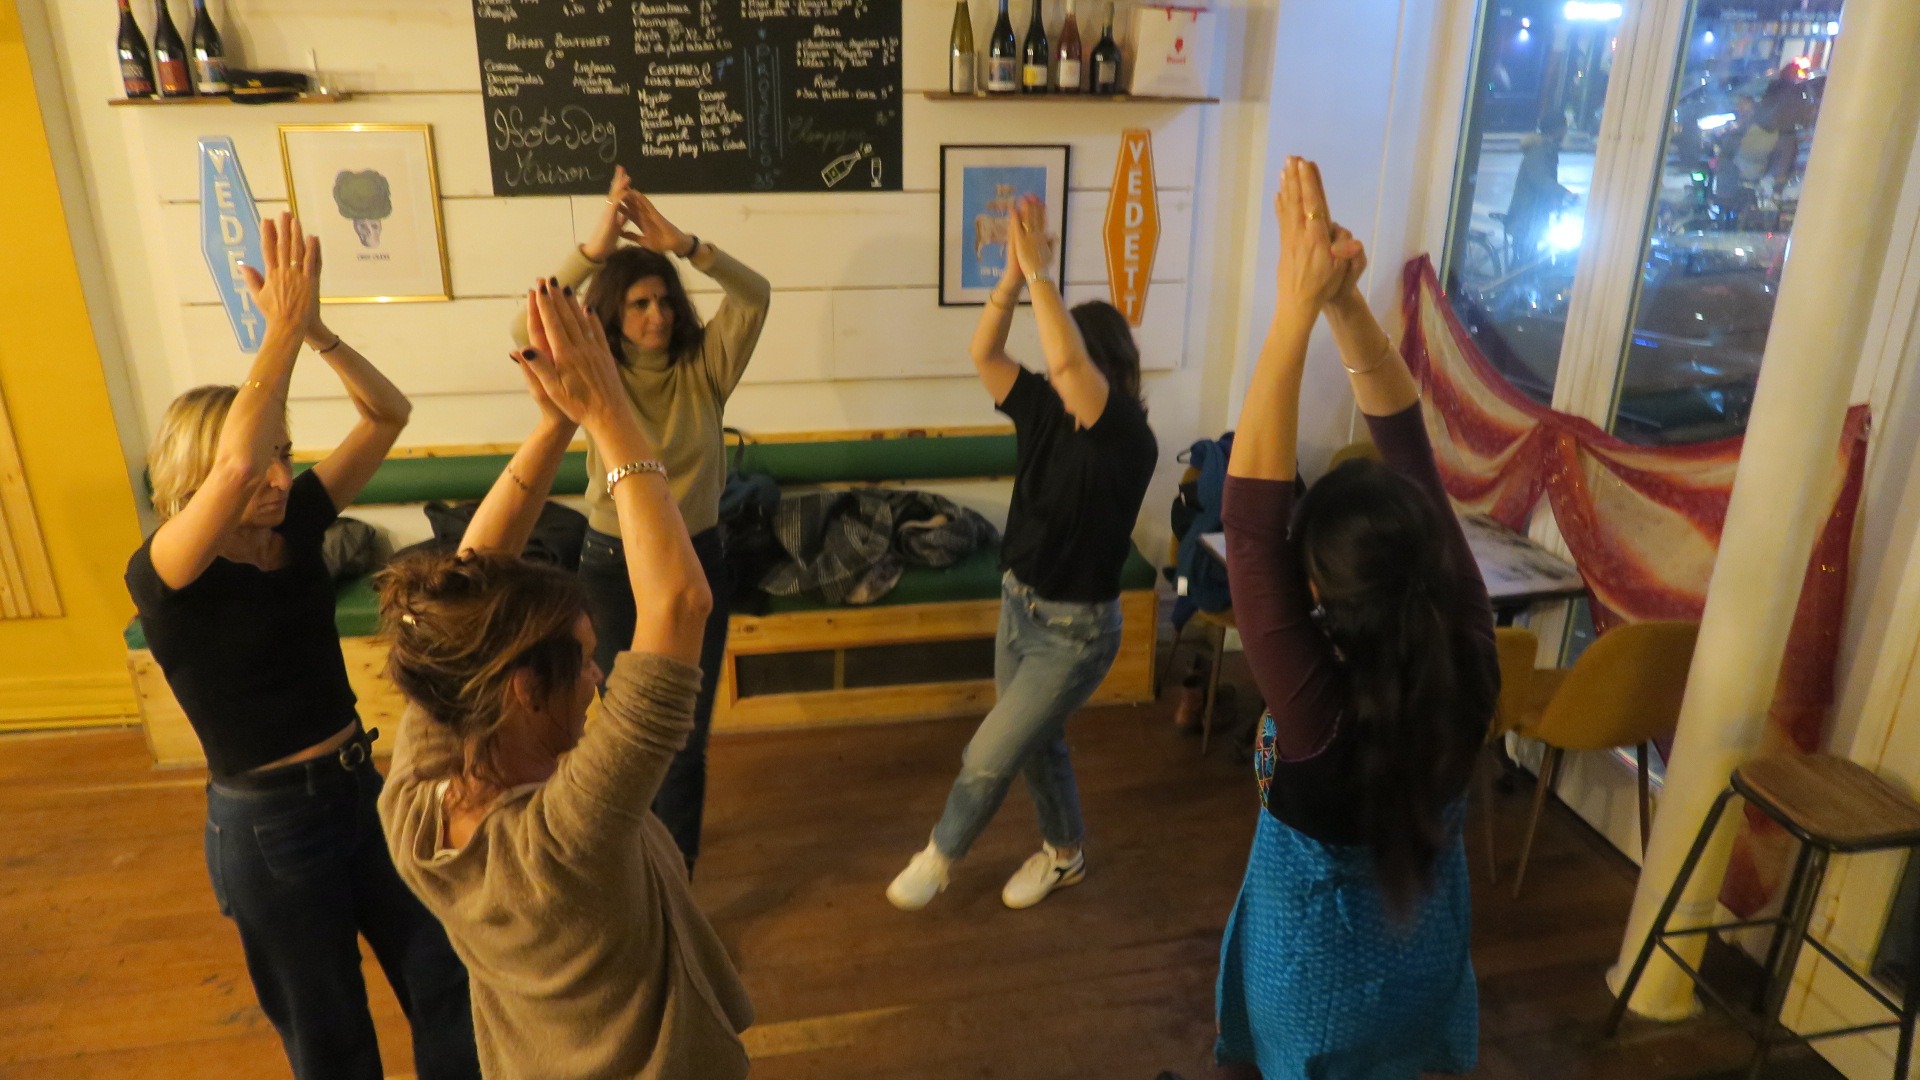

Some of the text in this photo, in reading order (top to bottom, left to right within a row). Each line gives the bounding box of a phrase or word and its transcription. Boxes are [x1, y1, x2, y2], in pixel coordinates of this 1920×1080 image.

[560, 104, 618, 163] Dog
[505, 150, 607, 187] Maison
[1123, 140, 1145, 317] VEDETT
